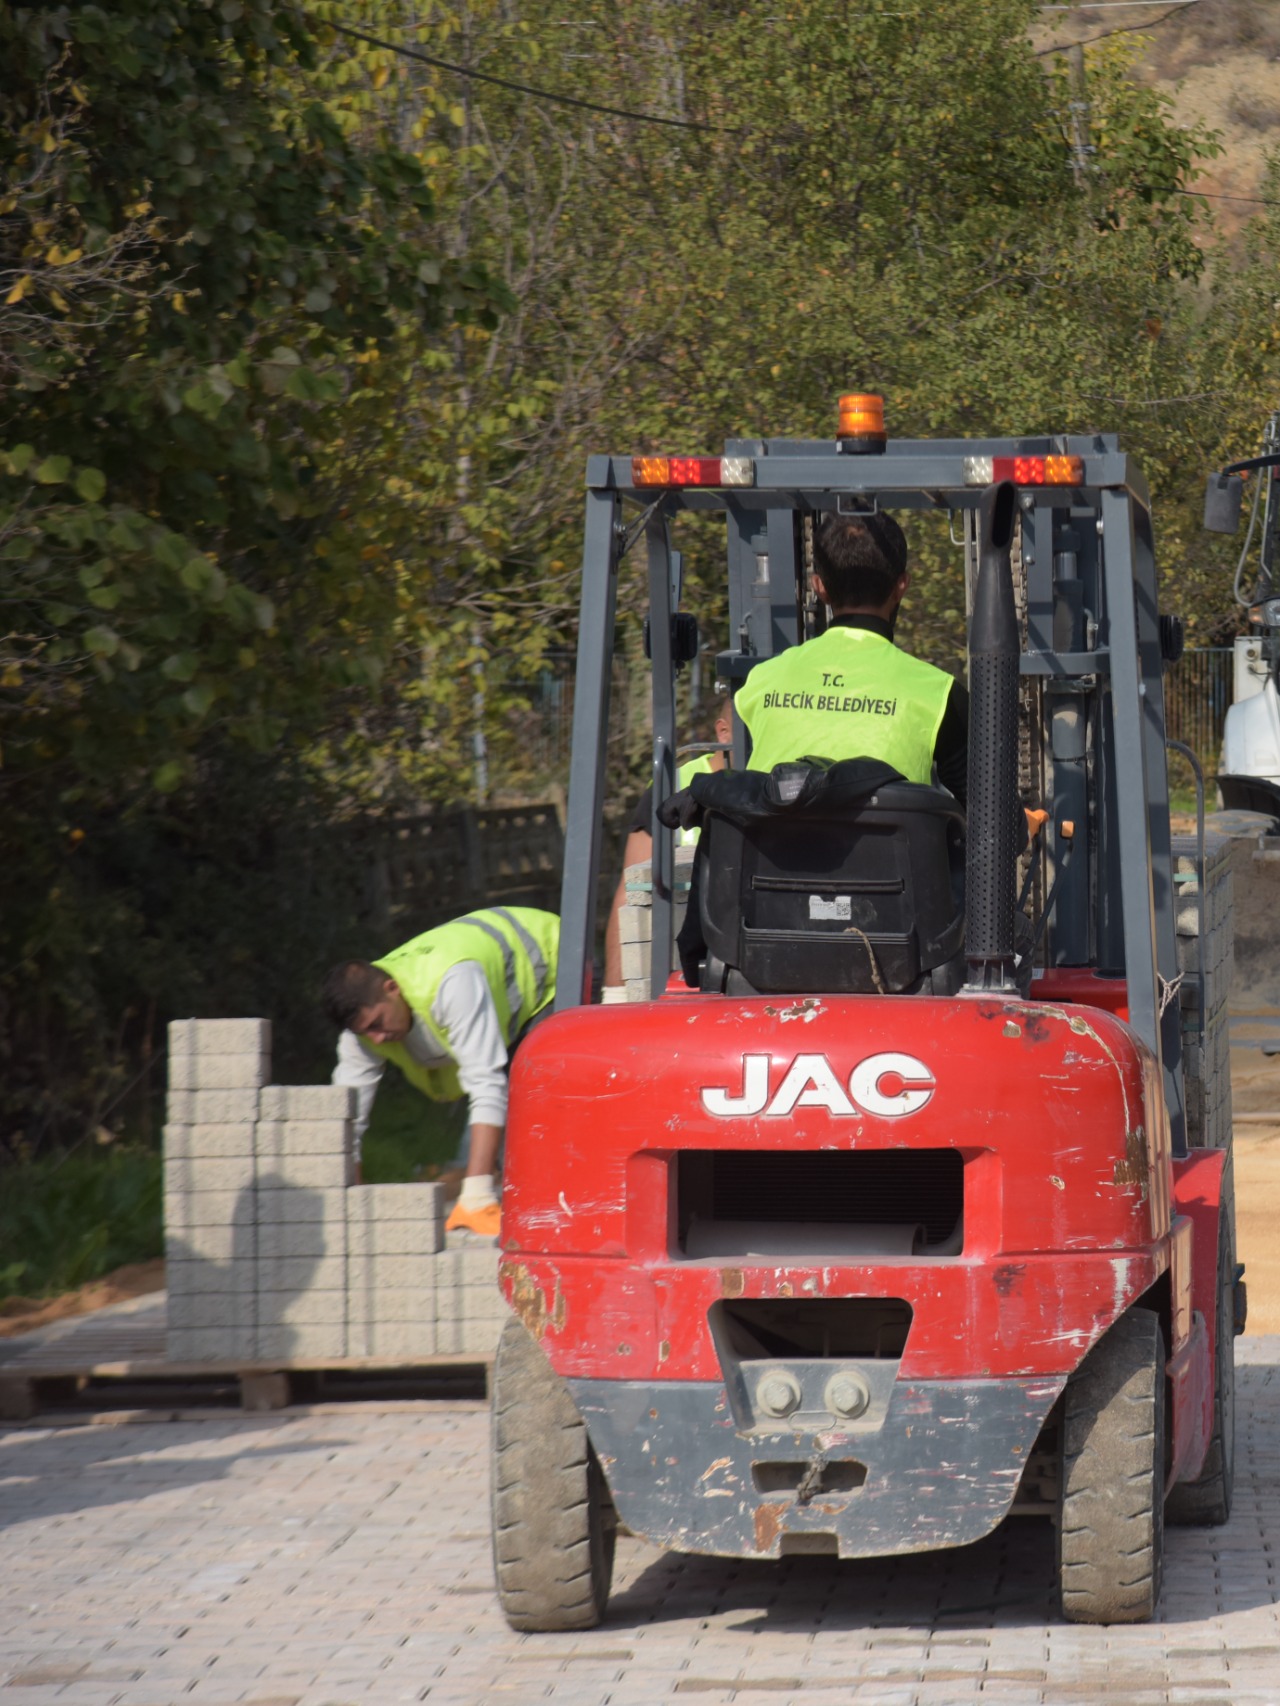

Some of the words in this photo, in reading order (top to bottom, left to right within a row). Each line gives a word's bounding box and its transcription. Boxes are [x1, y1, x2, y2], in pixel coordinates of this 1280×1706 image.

[822, 673, 845, 687] T.C.
[763, 690, 815, 710] BİLECİK
[816, 695, 897, 716] BELEDİYESİ
[700, 1052, 936, 1118] JAC
